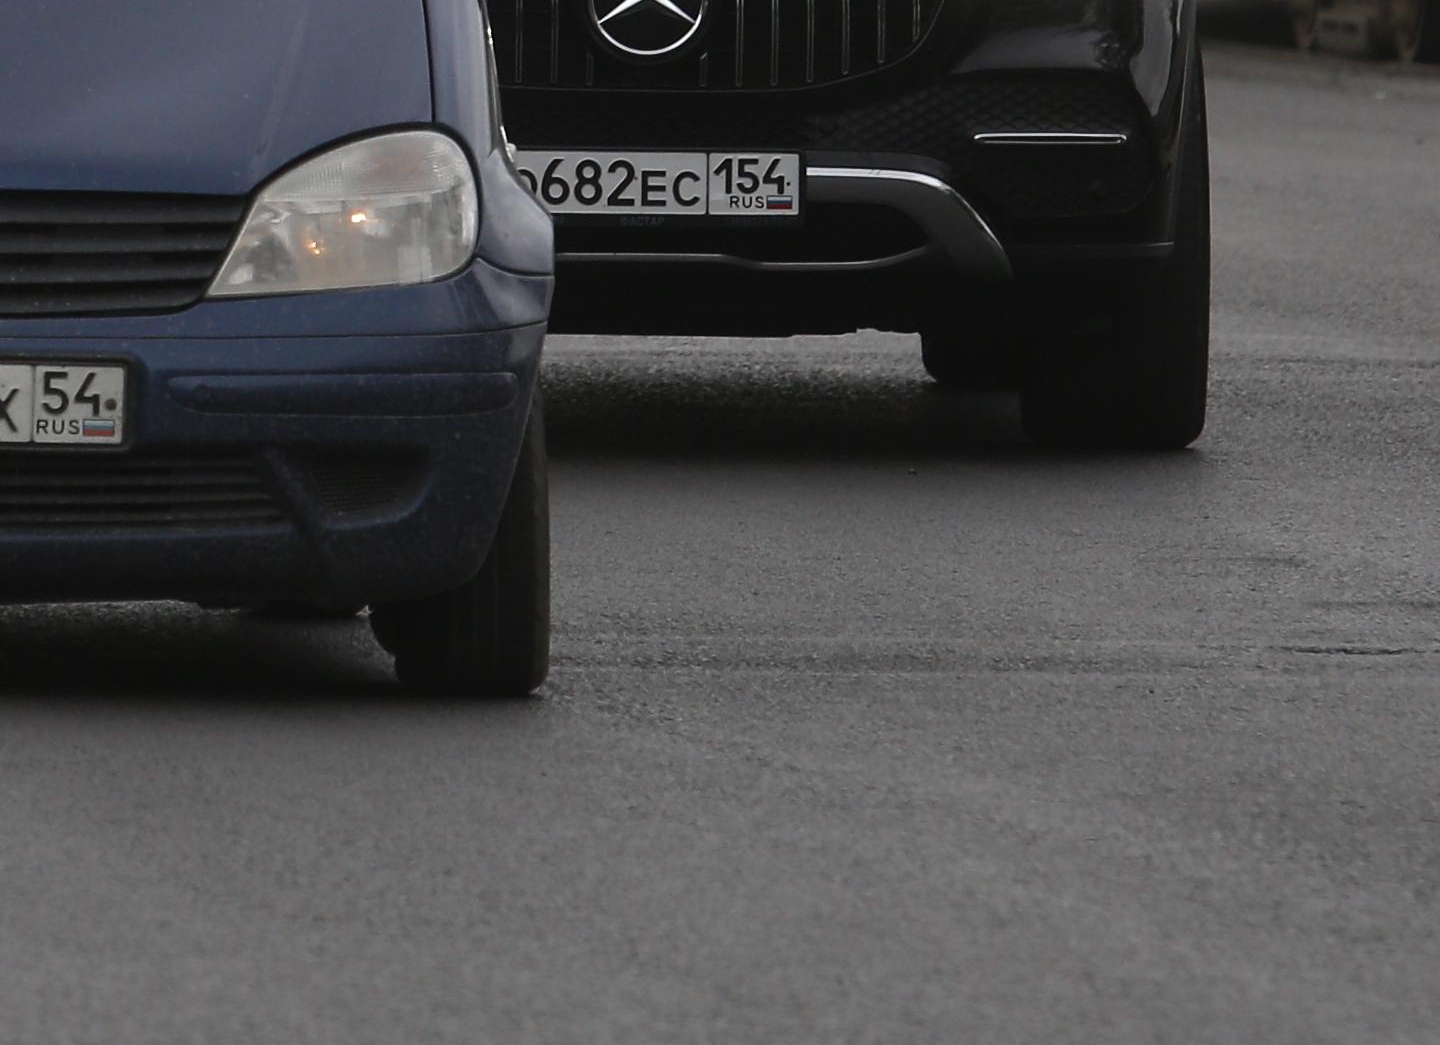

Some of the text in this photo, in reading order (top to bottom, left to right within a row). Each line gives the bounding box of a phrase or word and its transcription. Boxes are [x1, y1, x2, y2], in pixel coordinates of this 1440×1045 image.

[713, 158, 785, 195] 154
[729, 196, 765, 209] RUS
[41, 371, 101, 416] 54
[35, 419, 80, 436] RUS
